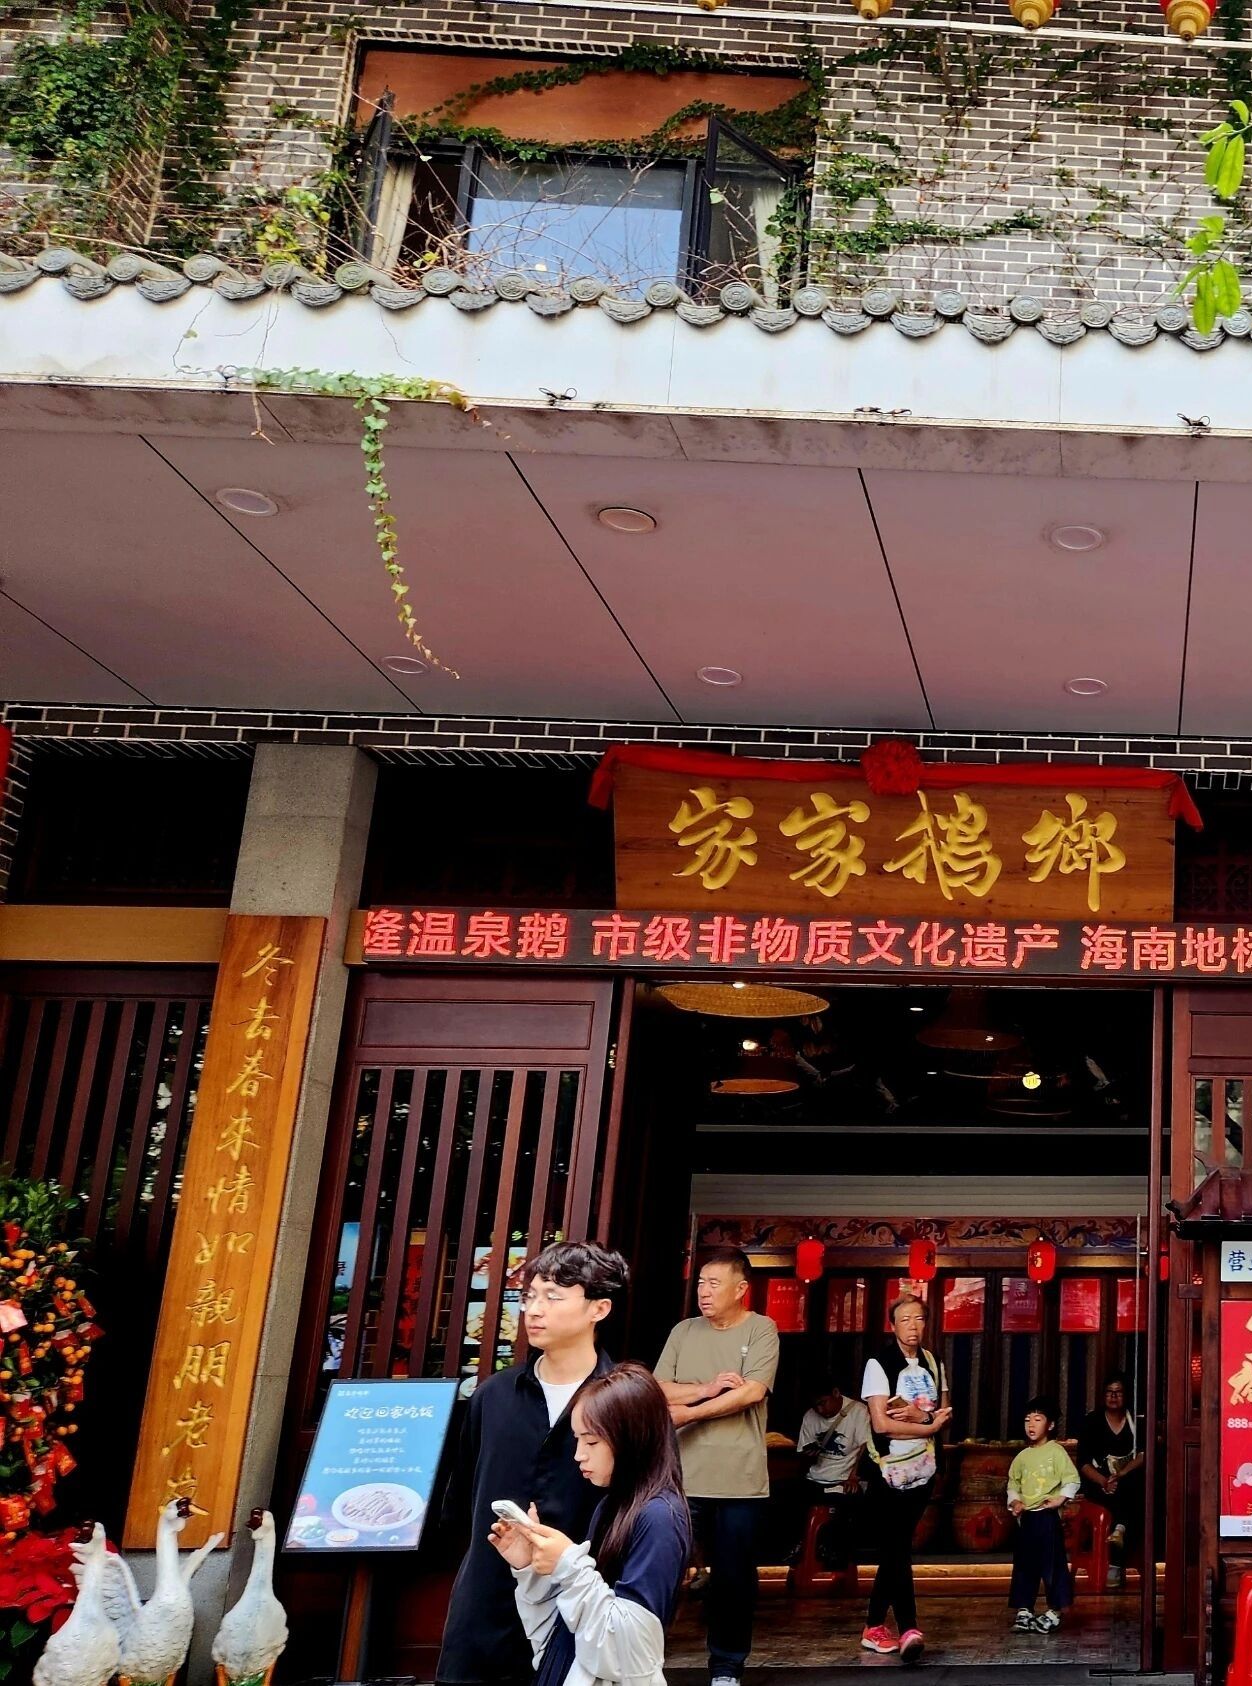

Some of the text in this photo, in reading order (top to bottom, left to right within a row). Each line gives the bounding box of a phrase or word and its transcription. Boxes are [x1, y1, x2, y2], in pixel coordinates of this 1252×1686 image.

[363, 909, 568, 958] 隆温泉鹅
[592, 914, 1060, 967] 市级非物质文化遗产
